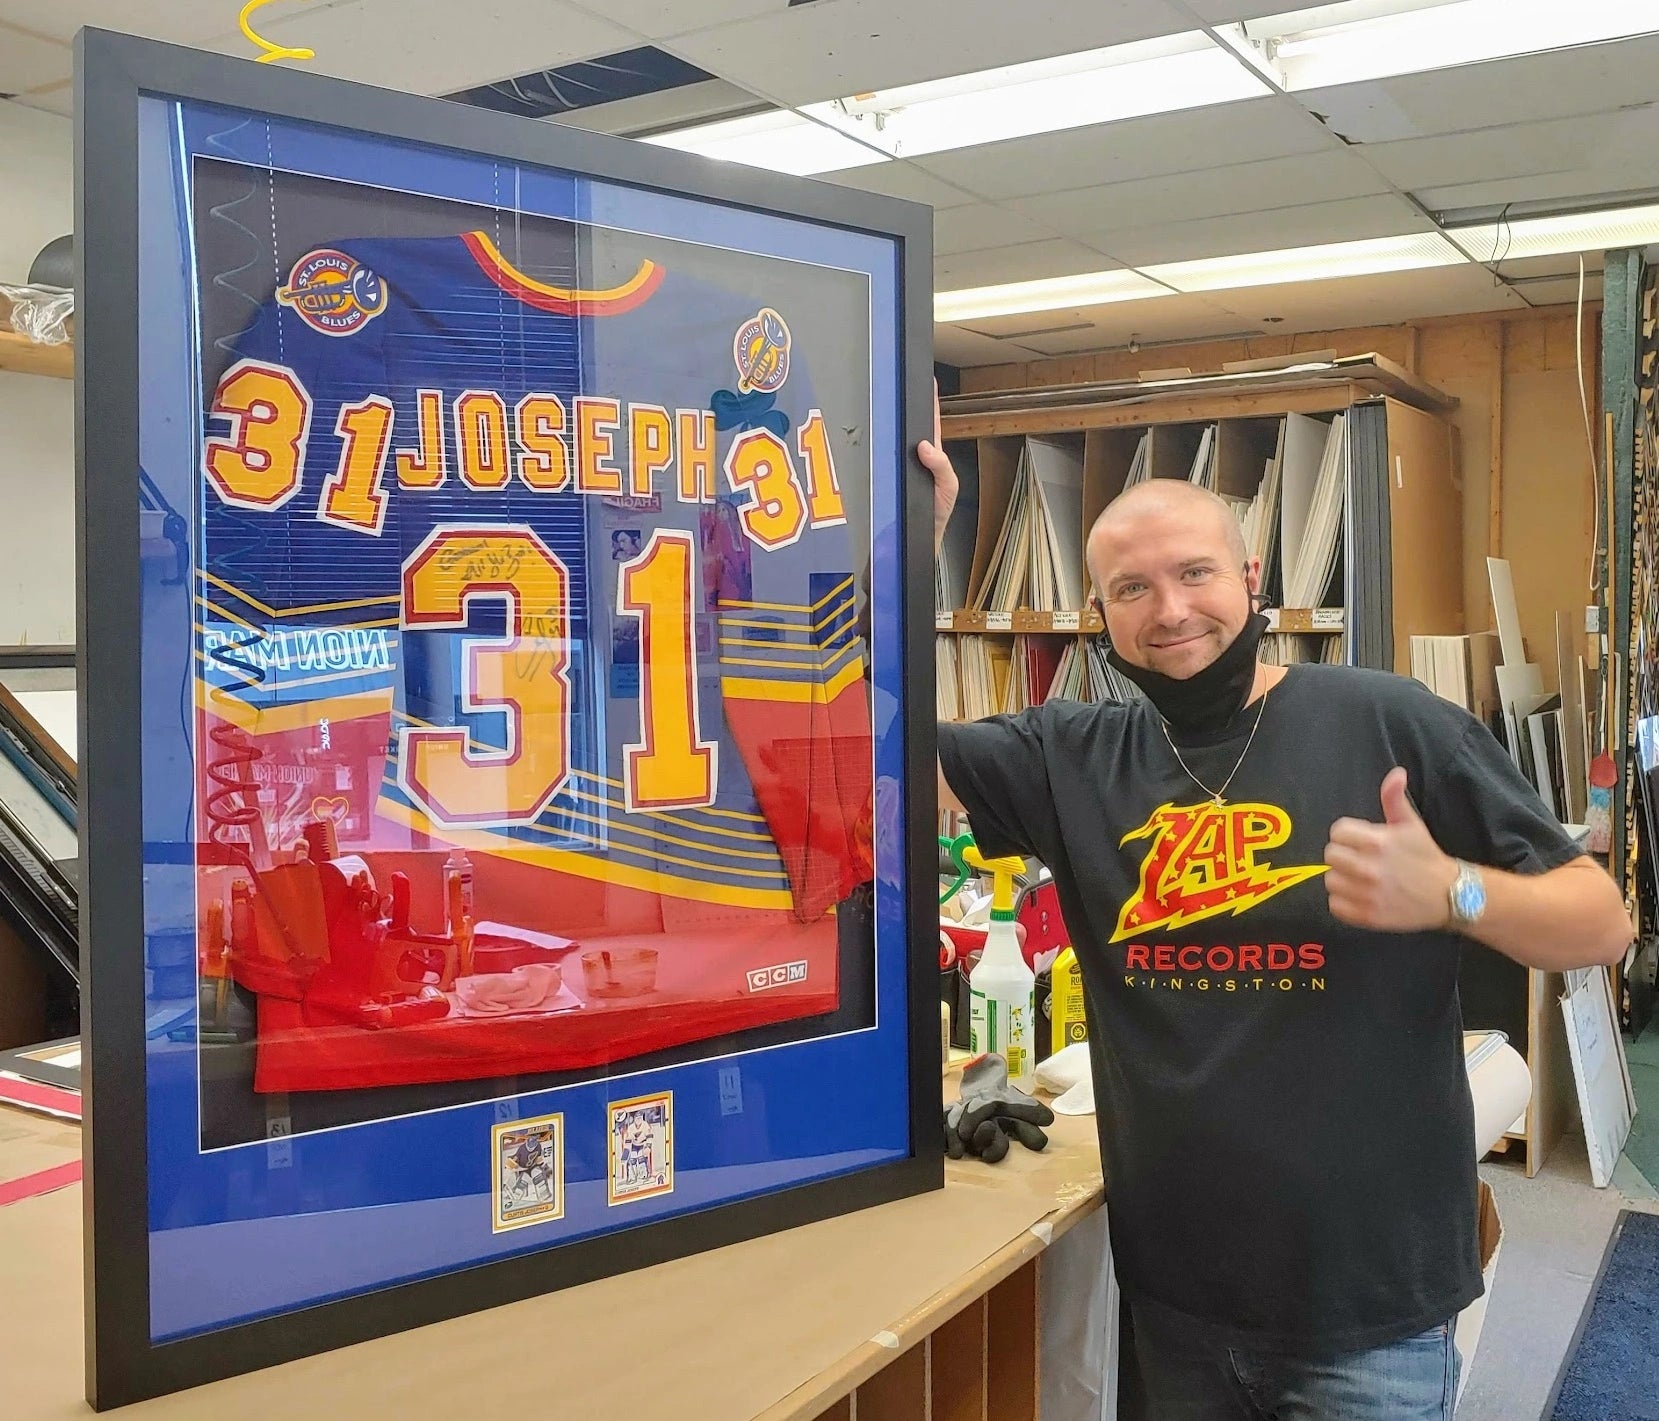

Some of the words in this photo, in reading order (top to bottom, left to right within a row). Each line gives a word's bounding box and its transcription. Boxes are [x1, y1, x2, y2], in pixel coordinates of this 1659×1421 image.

[308, 258, 349, 272] LOUIS
[320, 310, 361, 327] BLUES
[740, 325, 760, 351] LOUIS
[768, 353, 785, 384] BLUES
[202, 358, 396, 538] 31
[395, 388, 718, 505] JOSEPH
[722, 407, 848, 553] 31
[398, 522, 720, 832] 31
[1108, 801, 1333, 944] ZAP
[1125, 943, 1327, 972] RECORDS
[746, 960, 808, 992] CCM
